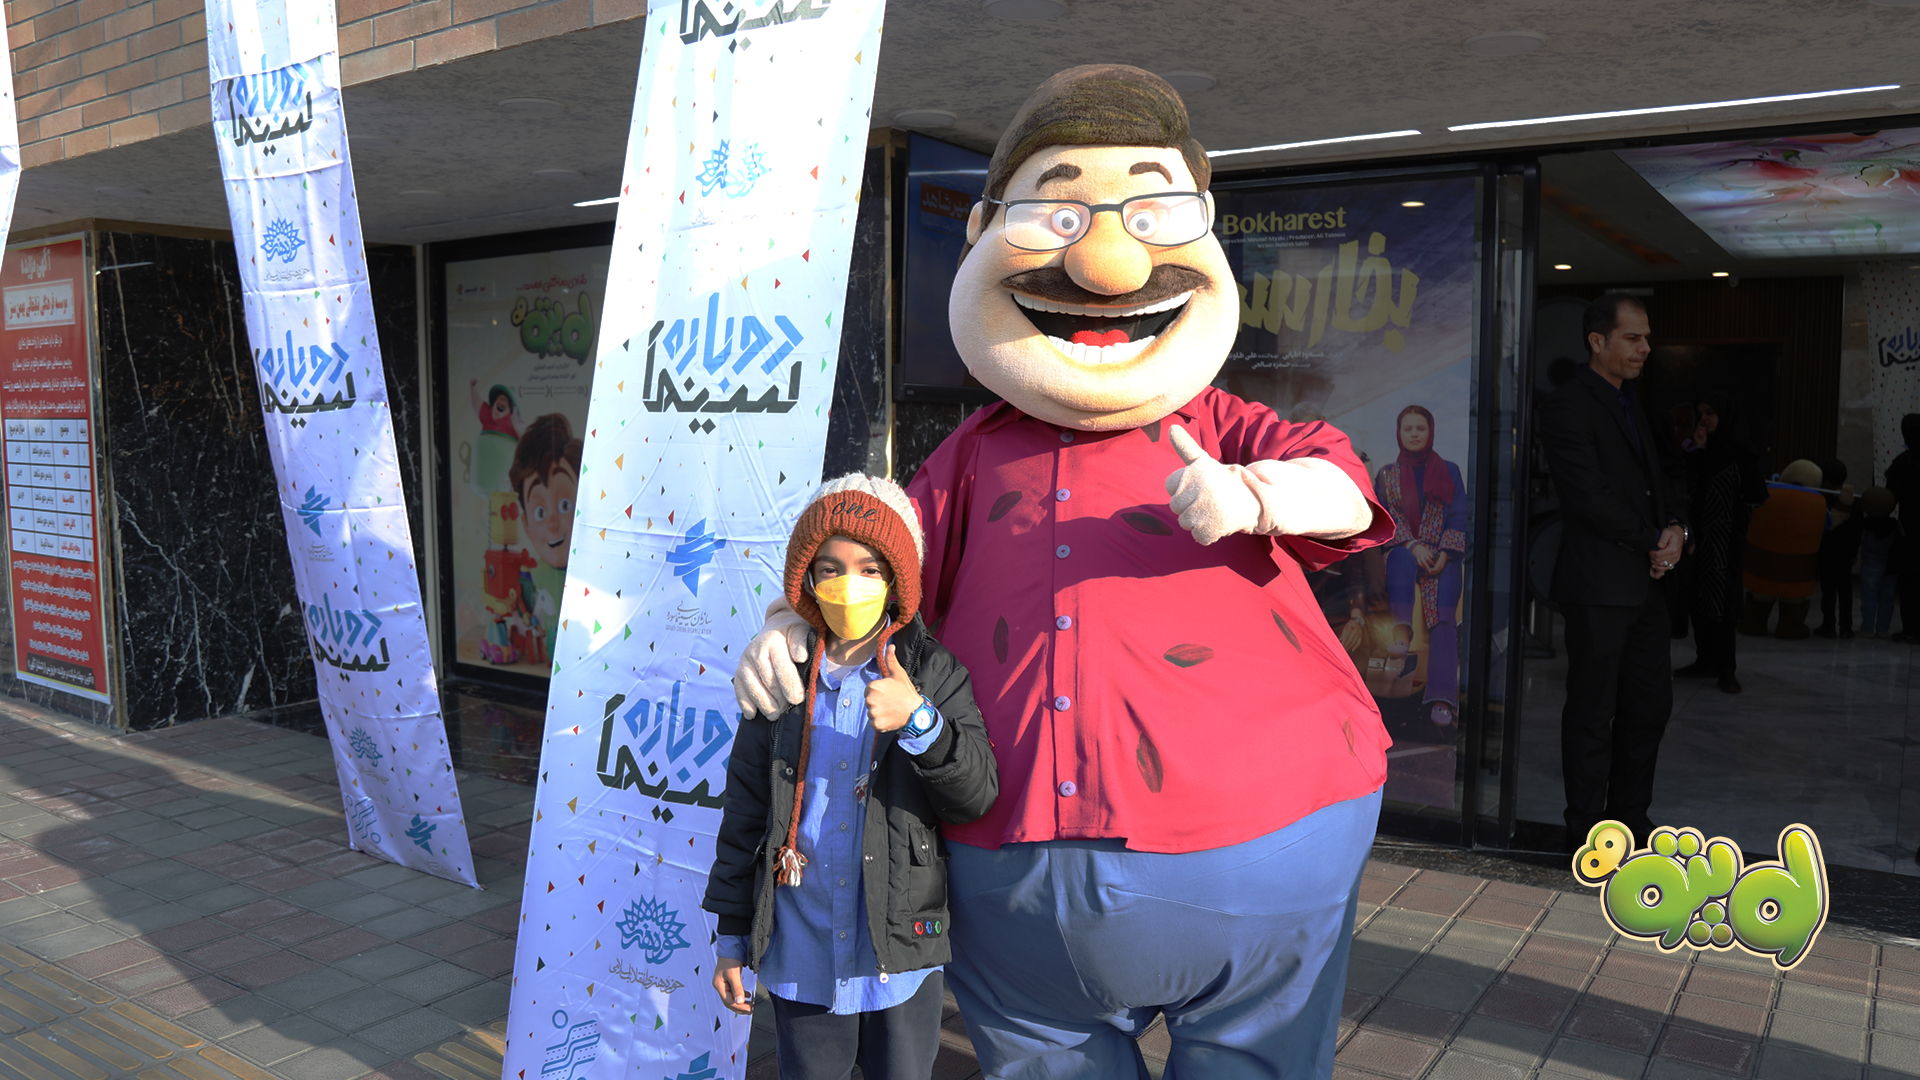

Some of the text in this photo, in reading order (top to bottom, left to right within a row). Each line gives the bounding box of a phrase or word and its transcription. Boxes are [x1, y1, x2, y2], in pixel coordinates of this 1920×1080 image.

[235, 54, 310, 123] دوباره
[1222, 206, 1347, 235] Bokharest
[1237, 231, 1420, 354] بخارس
[261, 329, 350, 399] دوباره
[642, 320, 803, 435] سینما
[662, 292, 805, 393] دوباره
[254, 347, 357, 428] سینما
[832, 501, 877, 522] one
[309, 592, 383, 658] دوباره
[622, 680, 743, 784] وباره
